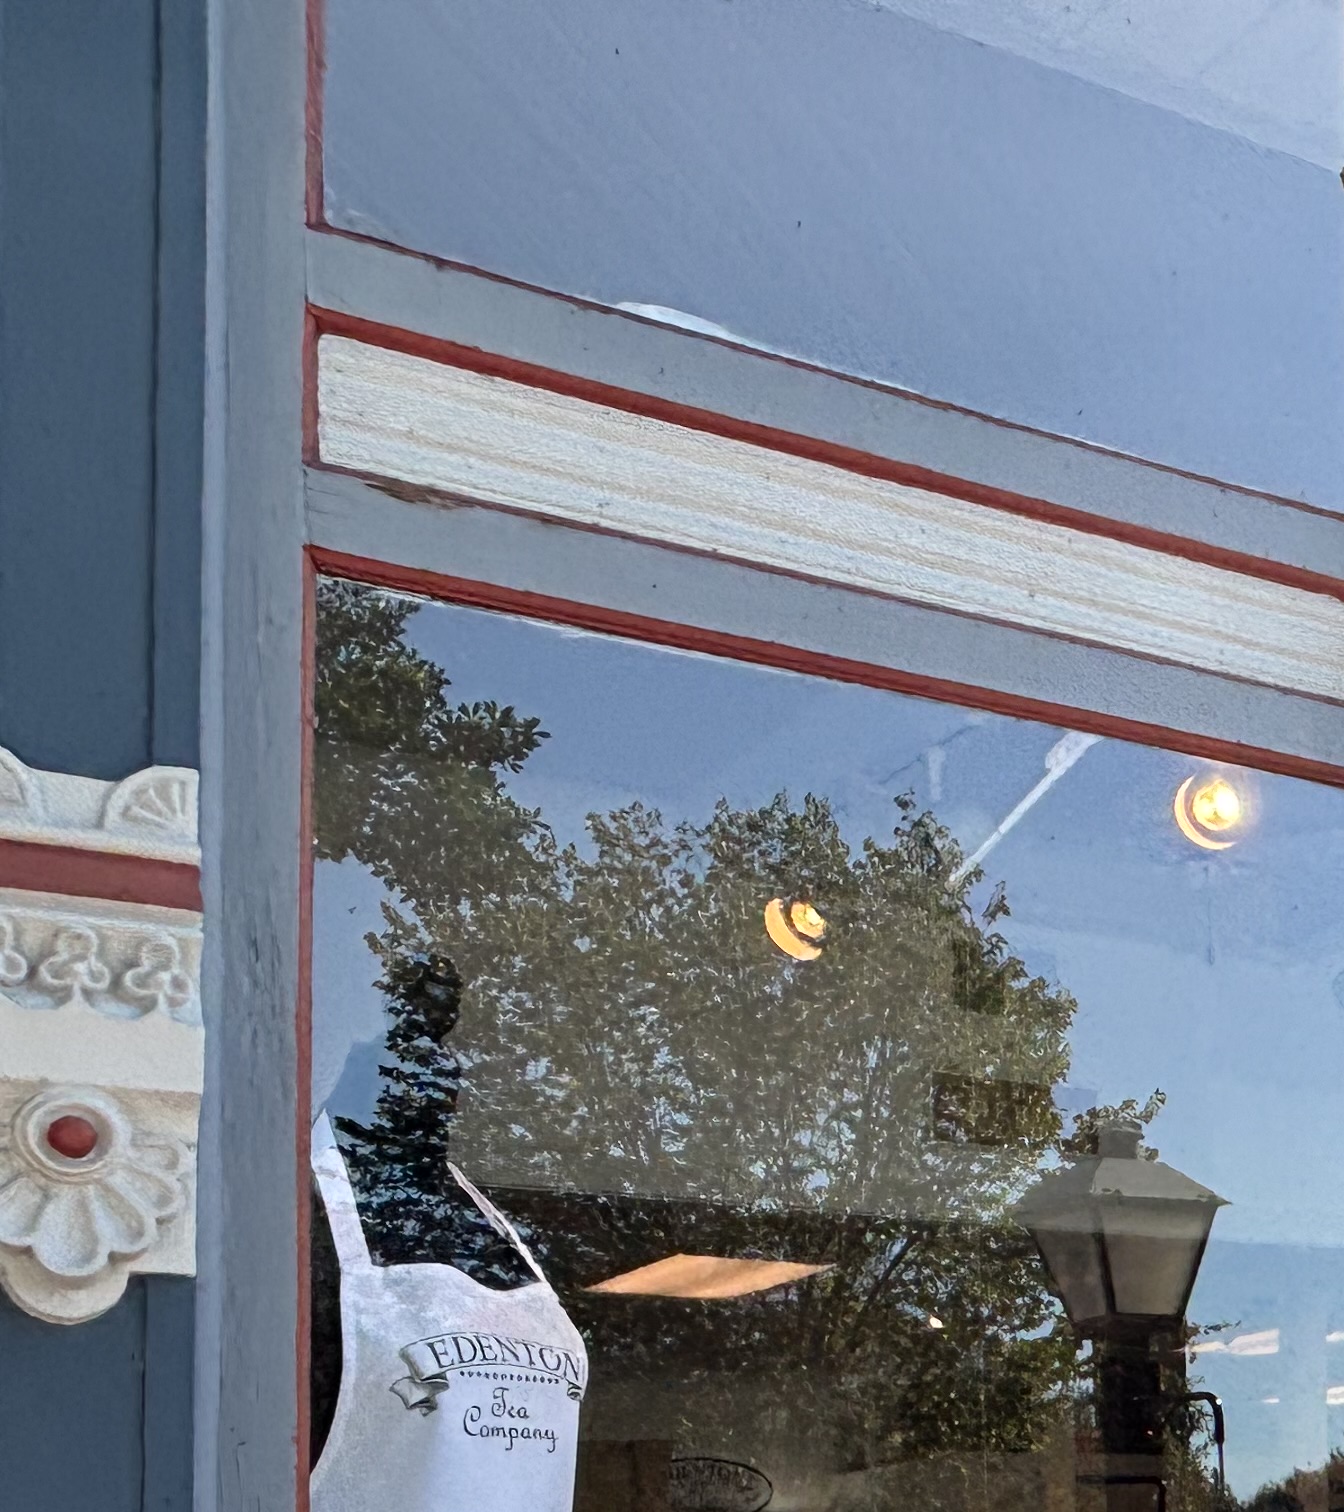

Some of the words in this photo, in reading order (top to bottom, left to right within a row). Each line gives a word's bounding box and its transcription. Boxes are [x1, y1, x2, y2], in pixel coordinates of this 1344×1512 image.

[427, 1334, 580, 1382] EDENTON
[491, 1386, 530, 1418] Tea
[463, 1405, 559, 1453] Company
